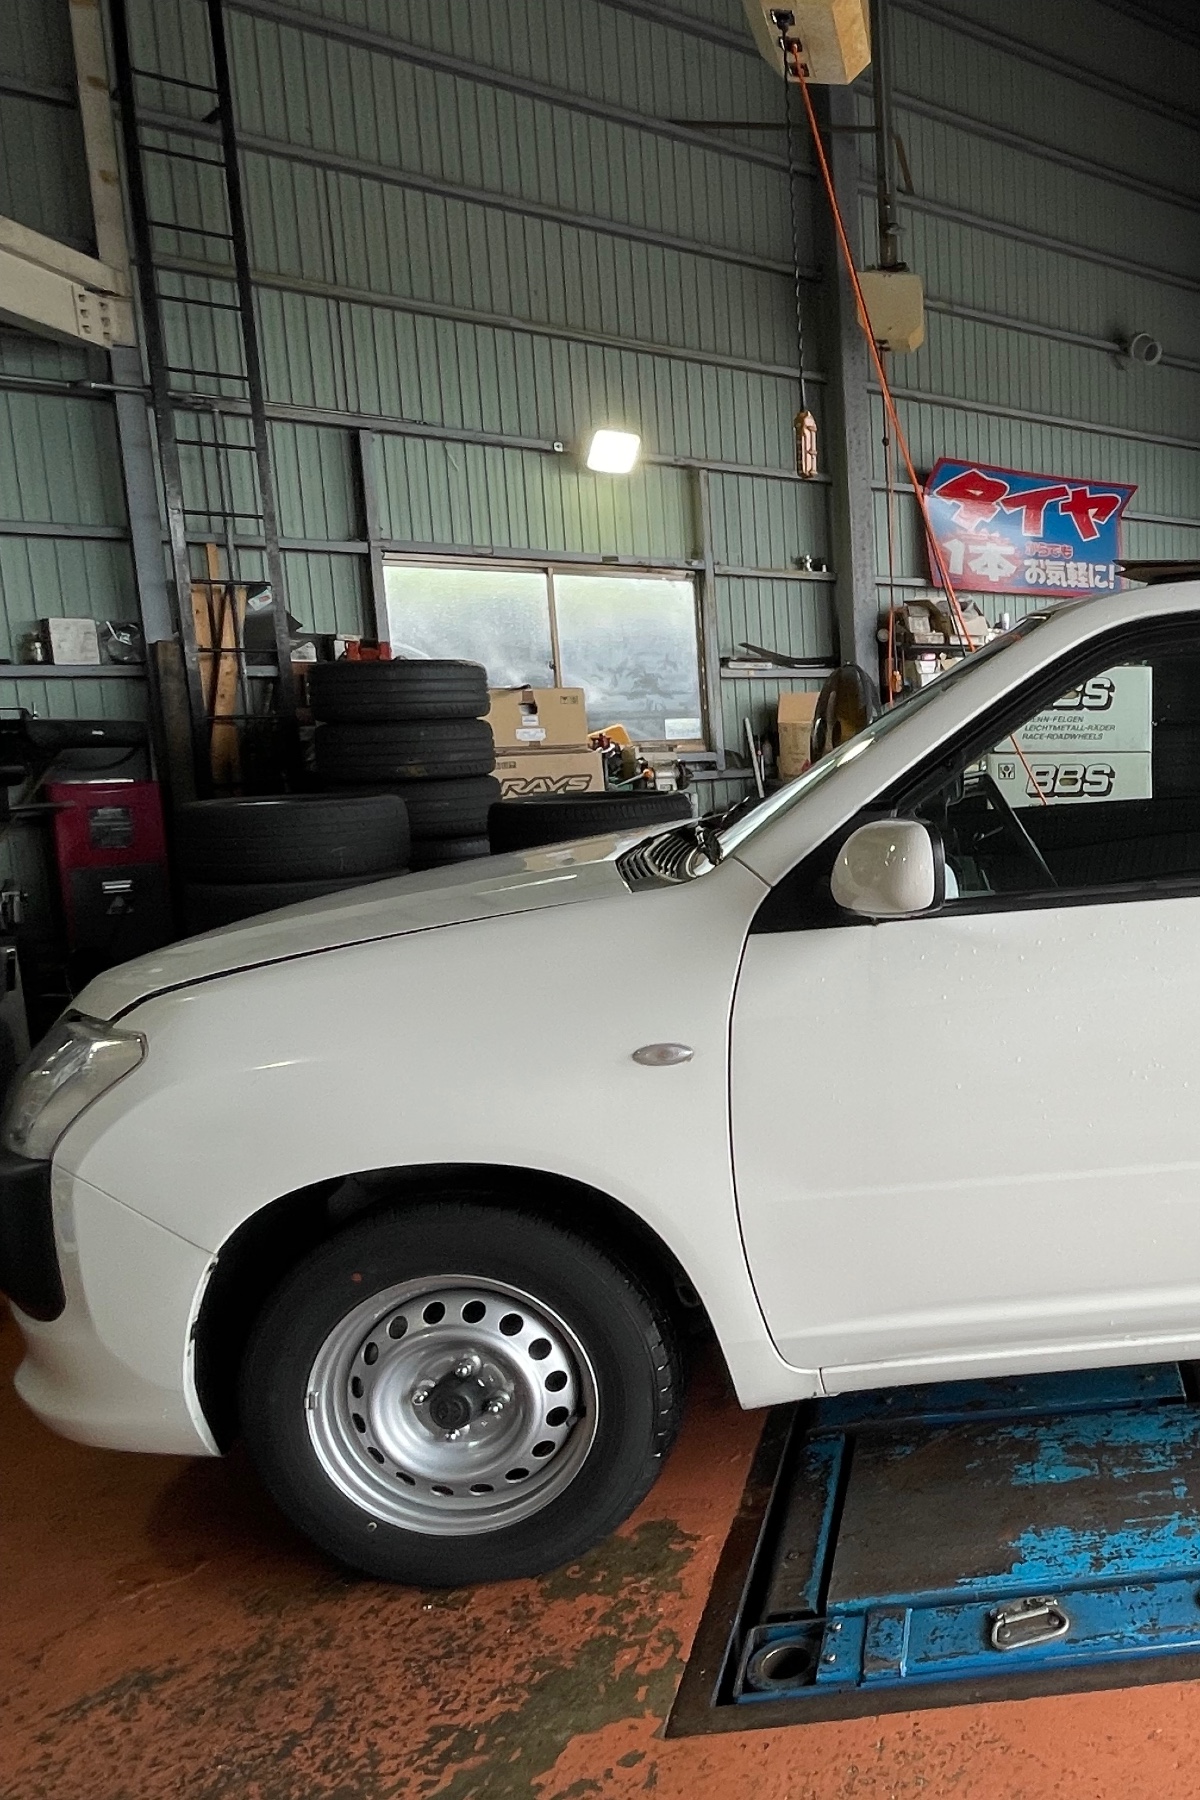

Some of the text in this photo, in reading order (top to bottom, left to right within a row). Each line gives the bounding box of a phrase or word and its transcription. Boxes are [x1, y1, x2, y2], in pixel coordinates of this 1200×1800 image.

[935, 469, 1121, 542] タイヤ
[943, 539, 1017, 581] 1本
[1023, 559, 1115, 589] お気軽に!
[500, 774, 593, 797] RAYS
[1025, 763, 1115, 798] BBS
